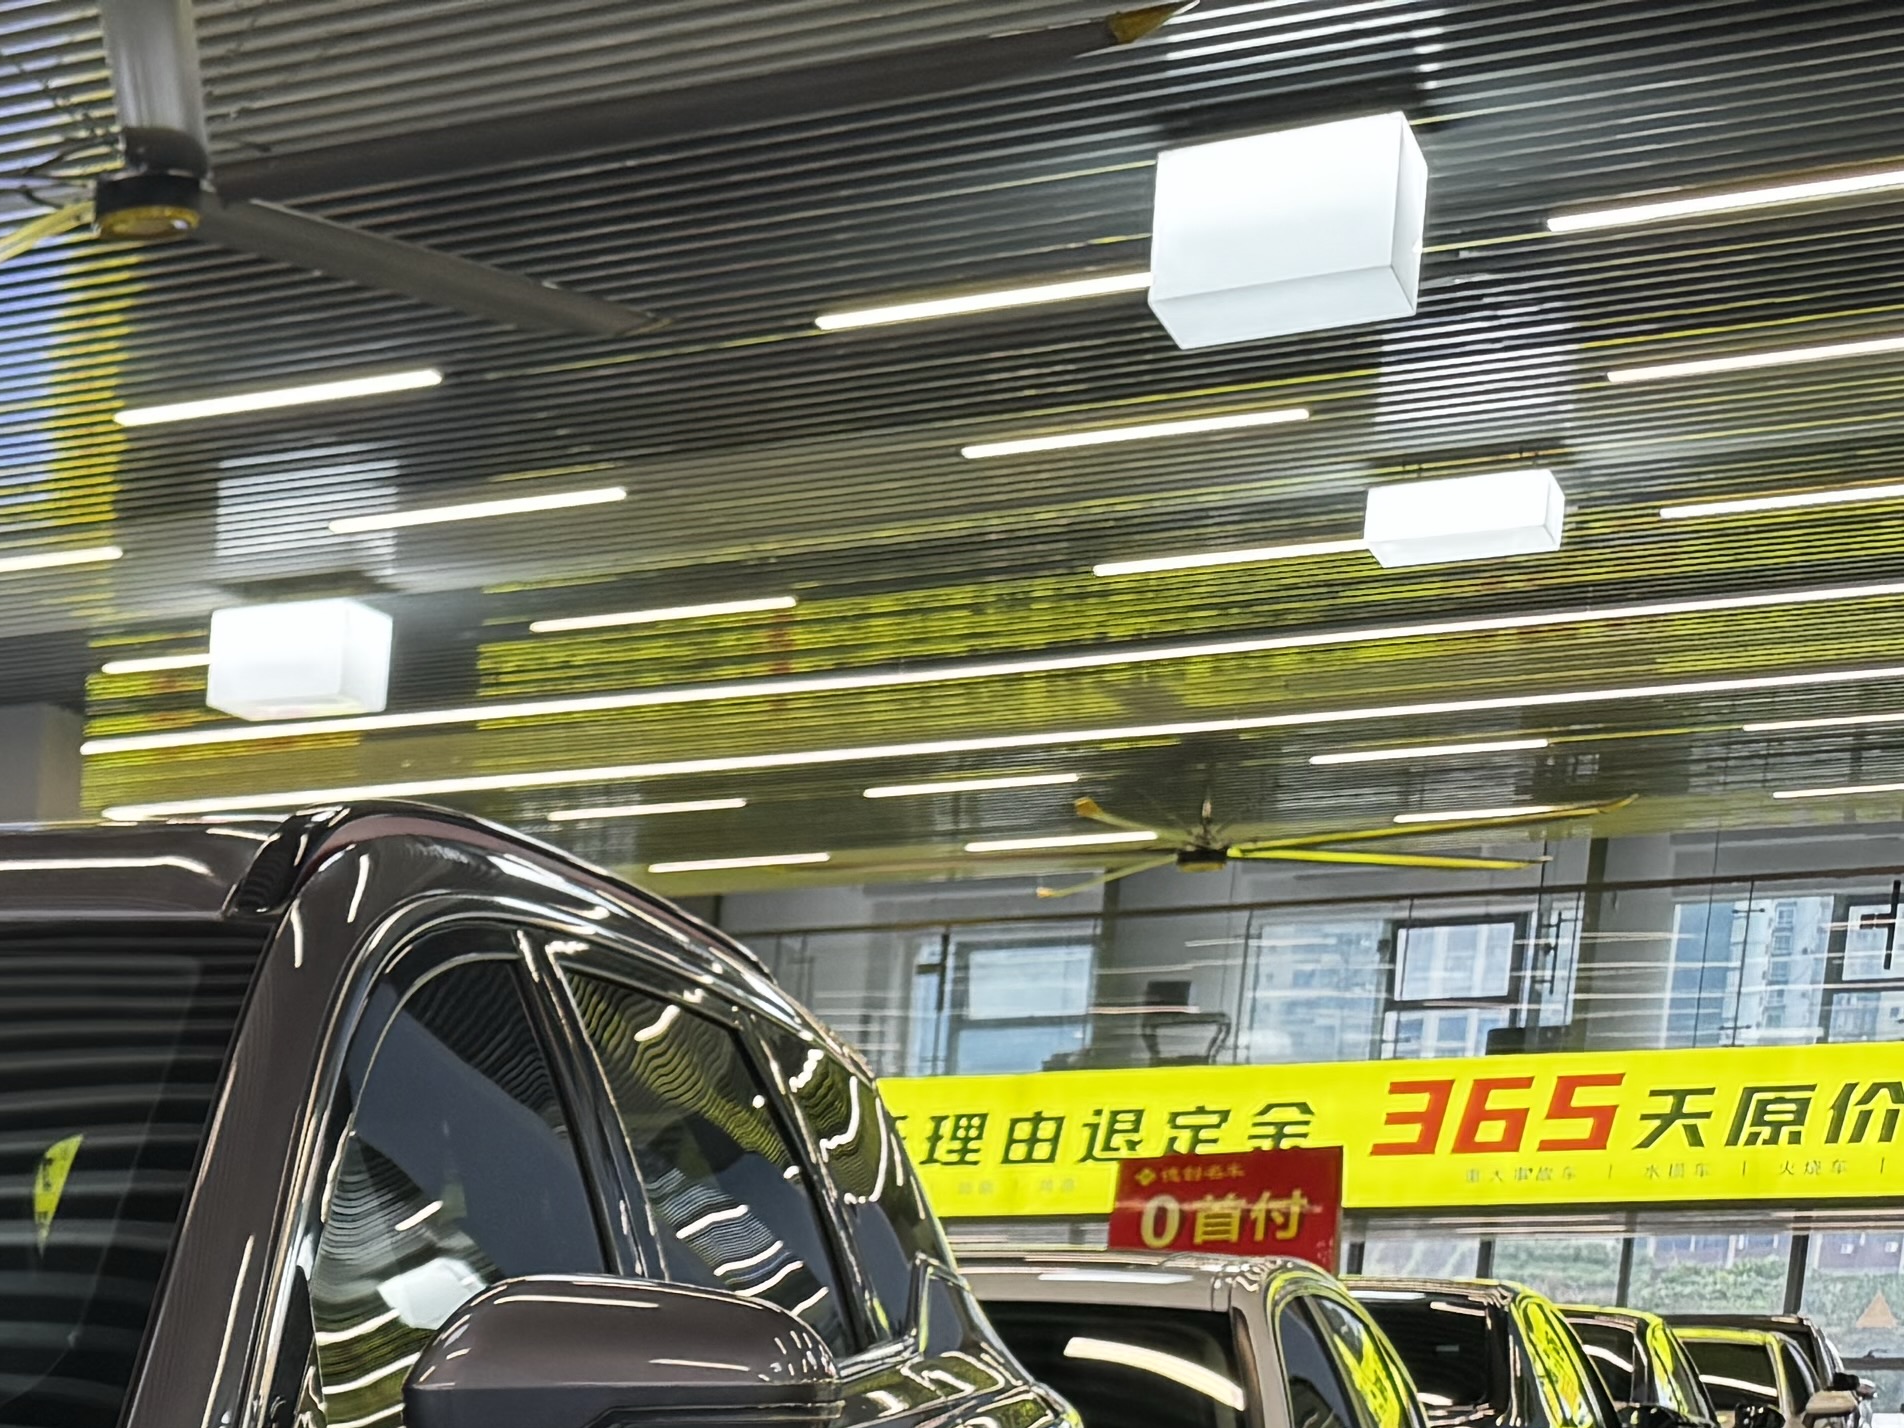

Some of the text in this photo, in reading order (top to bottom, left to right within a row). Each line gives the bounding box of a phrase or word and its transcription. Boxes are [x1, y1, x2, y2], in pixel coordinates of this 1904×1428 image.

[893, 1101, 1316, 1165] 理由退定金
[1140, 1188, 1309, 1249] 0首付
